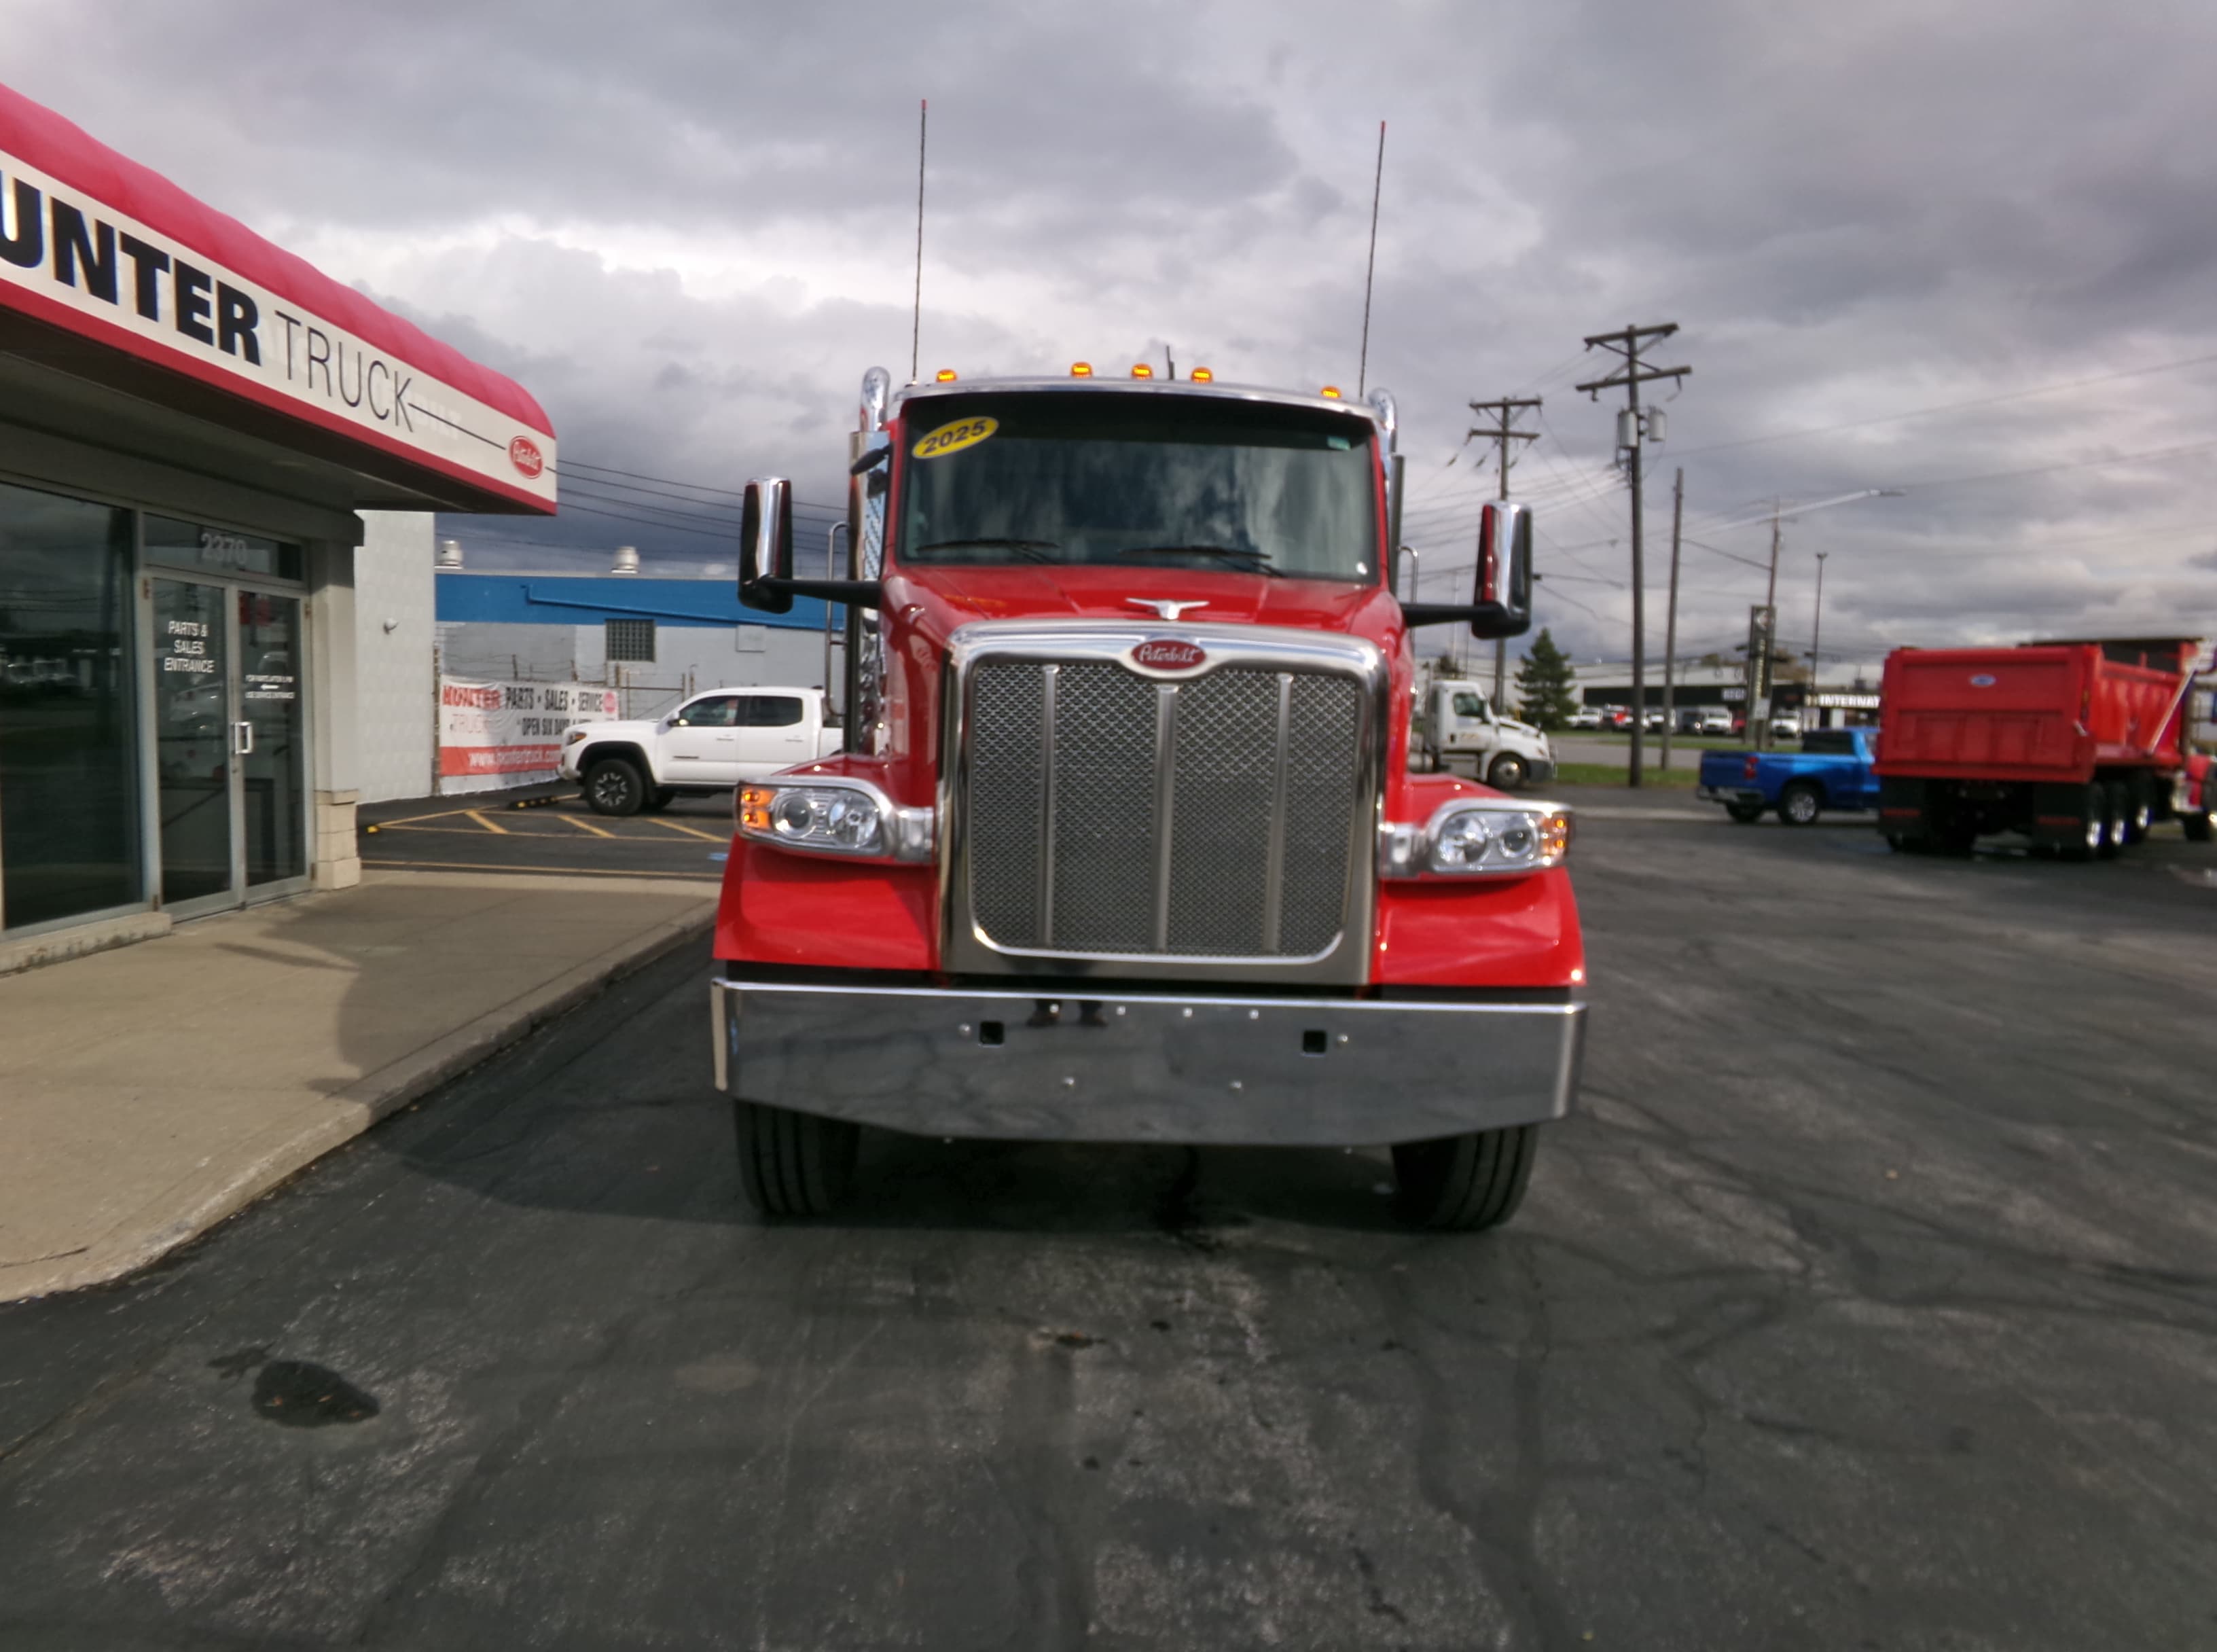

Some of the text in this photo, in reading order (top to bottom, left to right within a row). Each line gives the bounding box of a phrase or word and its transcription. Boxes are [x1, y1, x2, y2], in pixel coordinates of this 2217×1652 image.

[274, 310, 414, 433] TRUCK
[922, 419, 988, 455] 2025
[168, 620, 209, 637] PARTS &
[173, 639, 205, 655] SALES
[1138, 643, 1202, 663] Peterbilt
[164, 656, 215, 673] ENTRANCE
[505, 687, 535, 710] PARTS
[544, 688, 569, 711] SALES
[578, 691, 602, 712] SERVICE
[522, 717, 540, 736] OPEN
